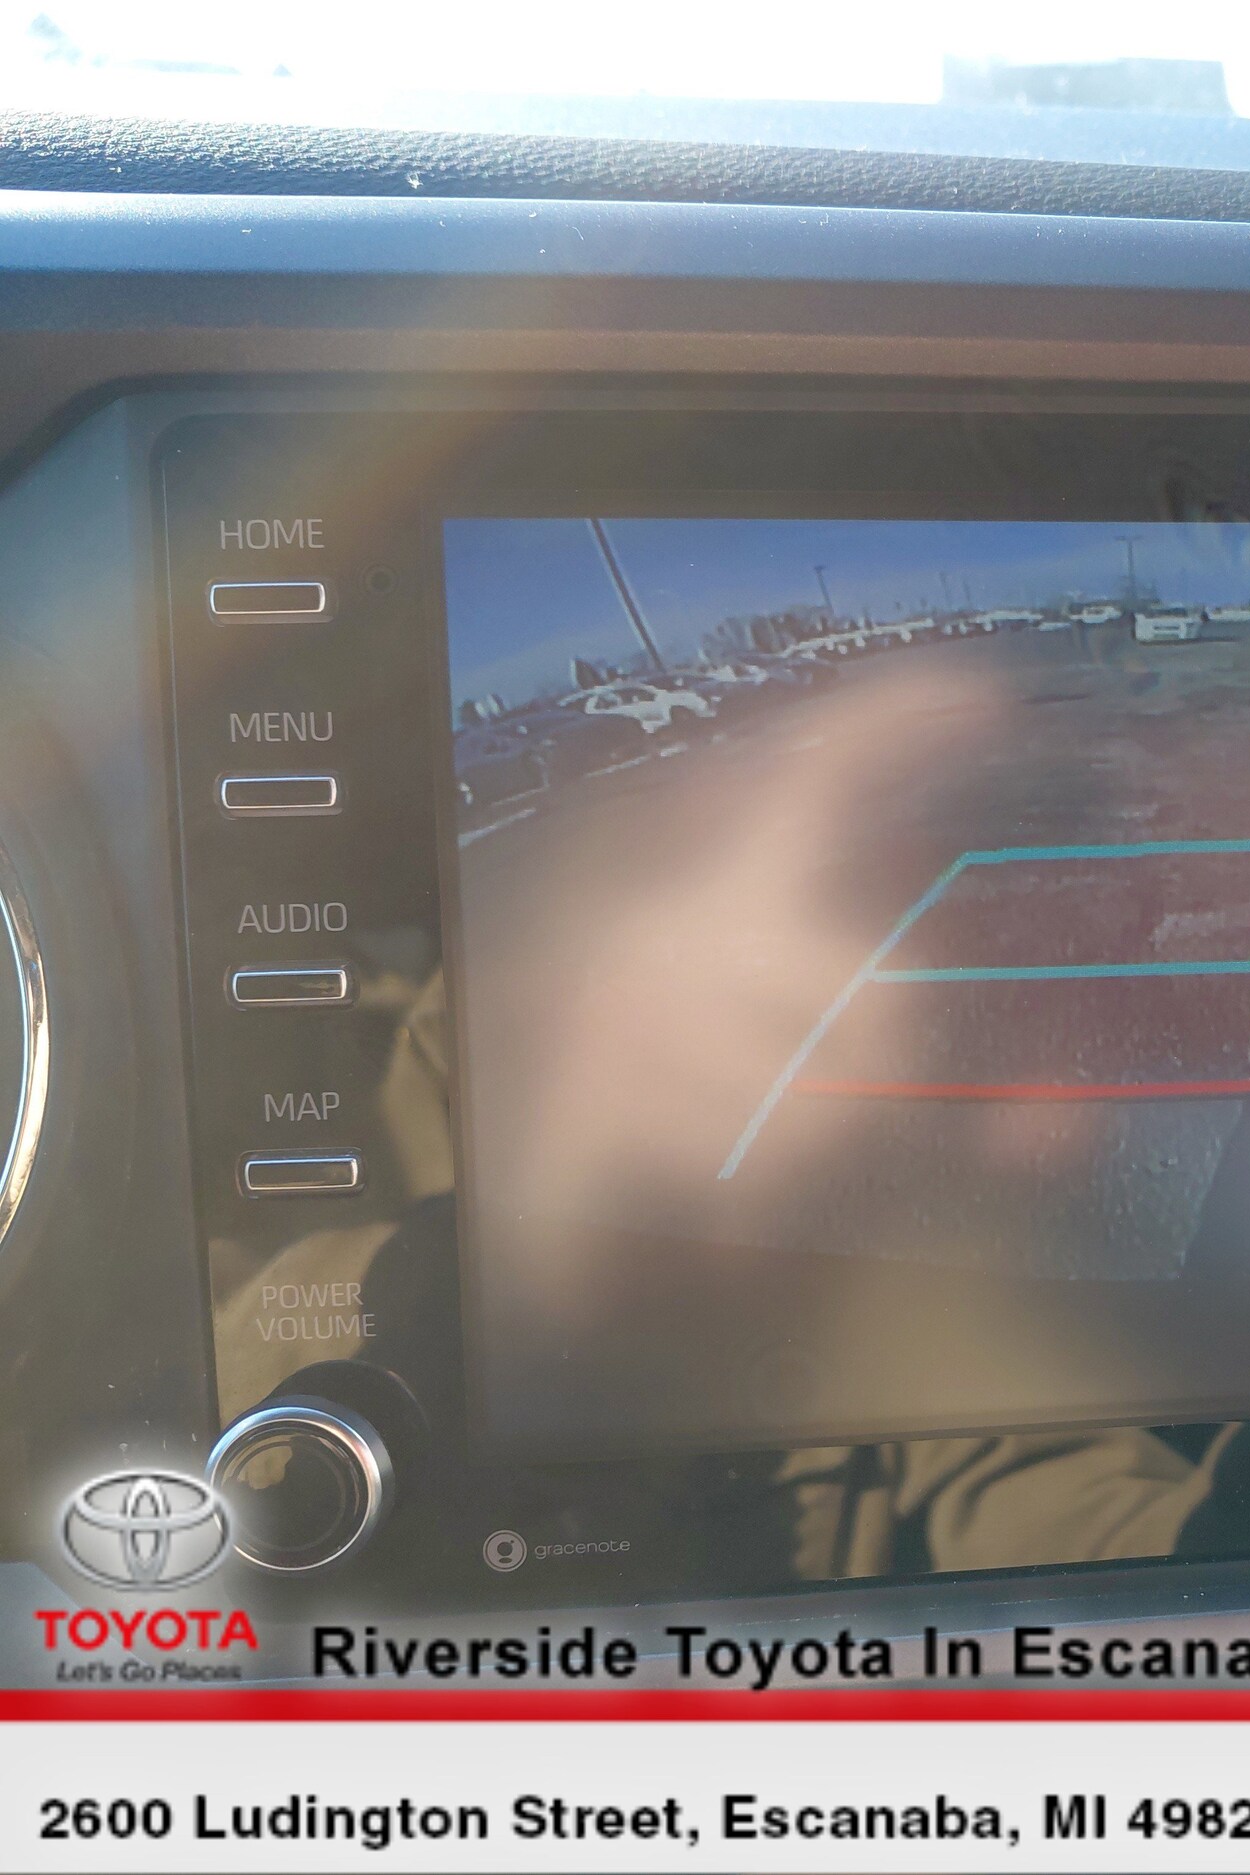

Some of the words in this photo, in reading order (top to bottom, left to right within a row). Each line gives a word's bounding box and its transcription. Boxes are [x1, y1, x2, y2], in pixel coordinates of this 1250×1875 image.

[219, 518, 326, 550] HOME
[229, 711, 334, 743] MENU
[237, 902, 348, 934] AUDIO
[263, 1091, 341, 1122] MAP
[261, 1282, 364, 1310] POWER
[255, 1313, 377, 1342] VOLUME
[534, 1539, 631, 1560] gracenote
